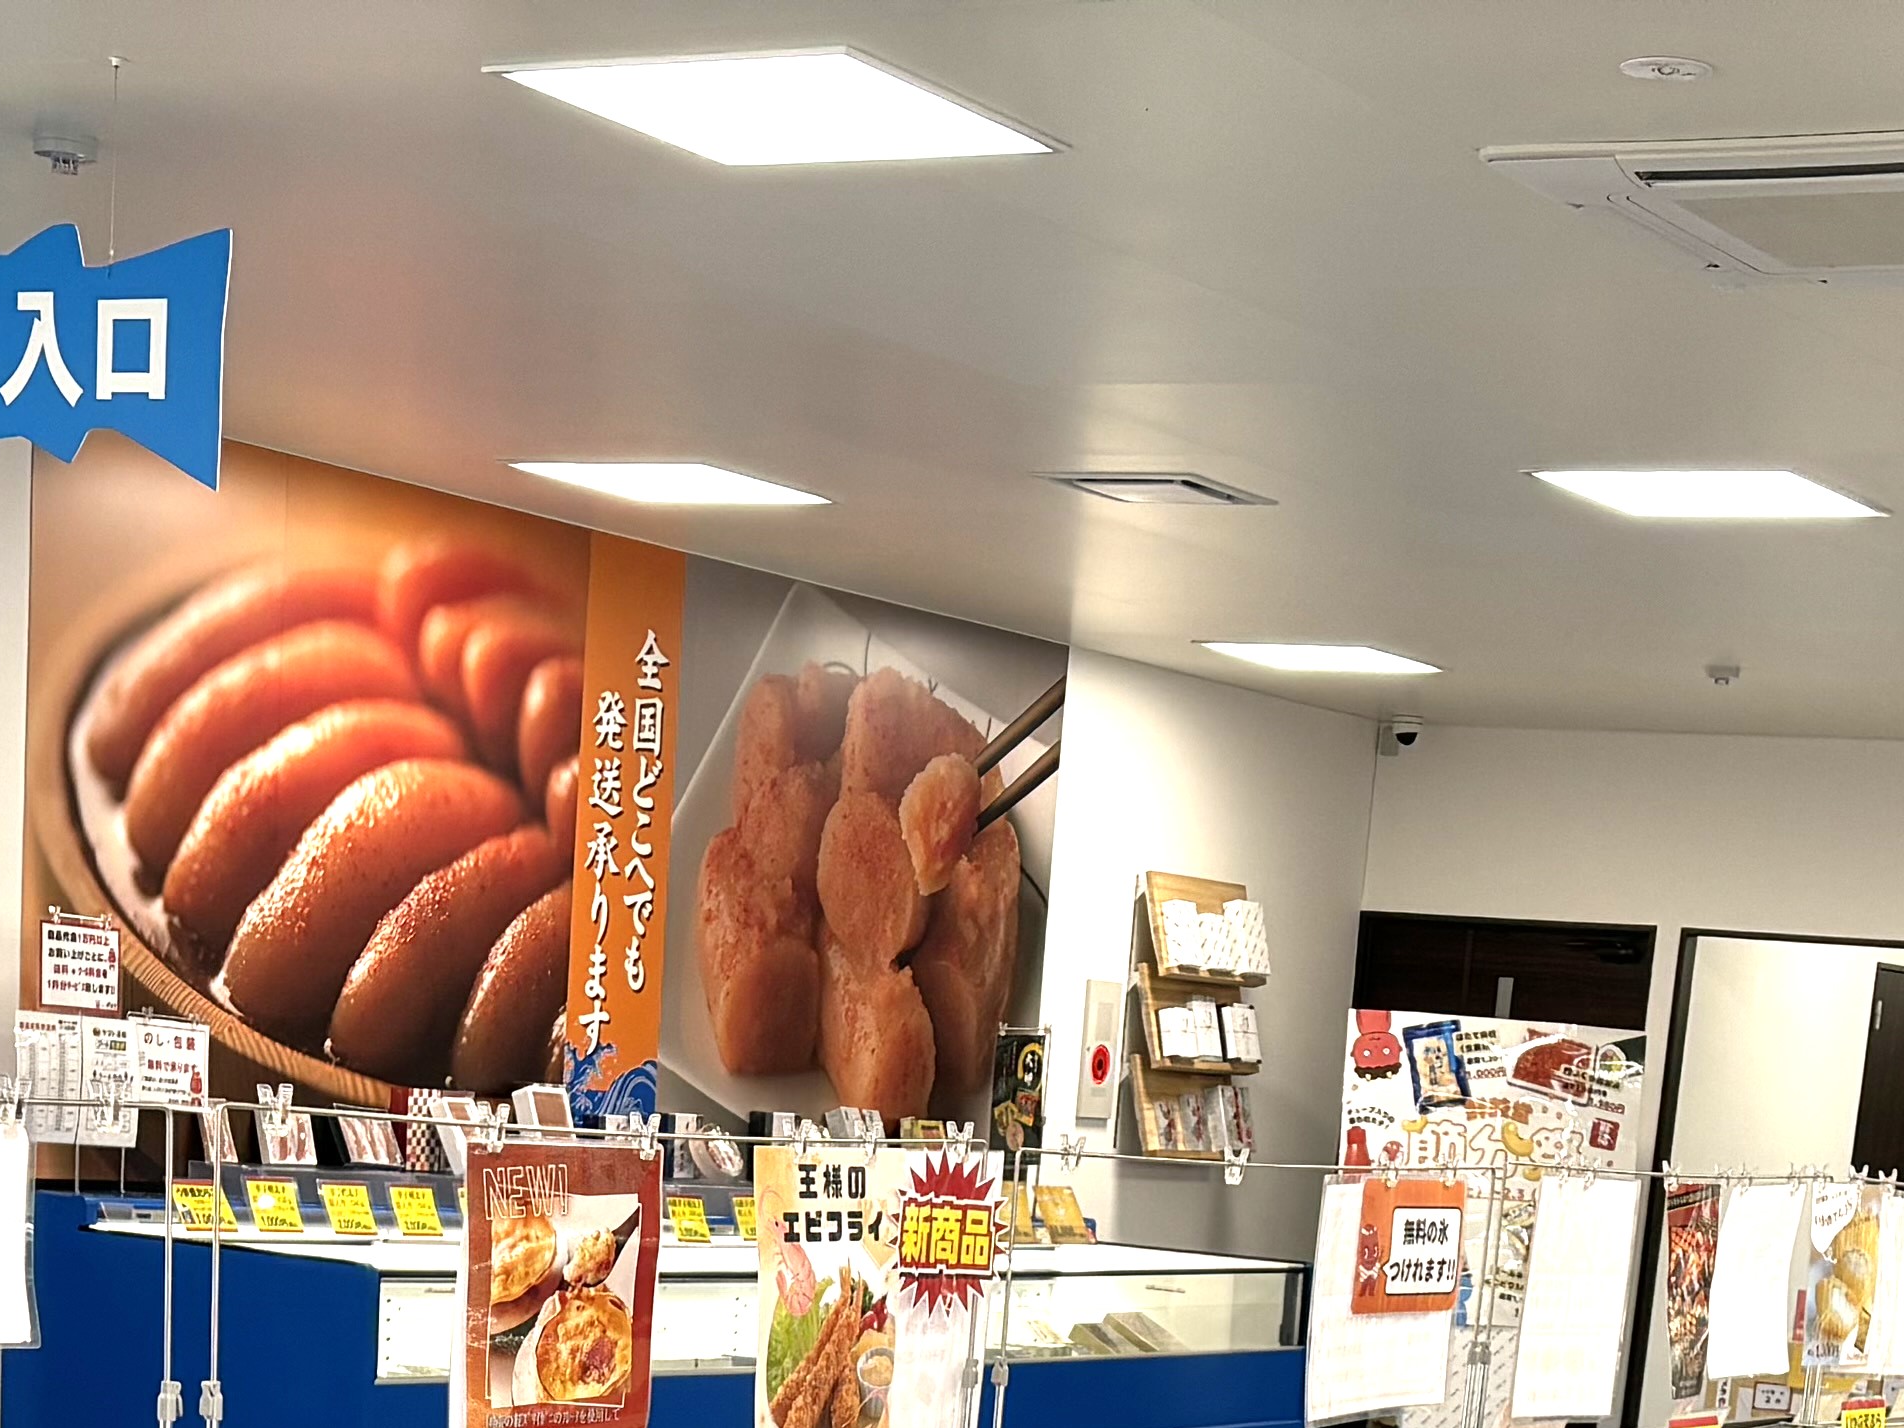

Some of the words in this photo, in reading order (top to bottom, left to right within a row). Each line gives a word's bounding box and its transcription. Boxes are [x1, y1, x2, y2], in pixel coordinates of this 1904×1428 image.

[623, 629, 671, 993] 全国どこへでも
[577, 689, 629, 1057] 発送承ります
[797, 1164, 866, 1199] 王様の
[782, 1210, 884, 1243] エビフライ
[901, 1199, 994, 1267] 新商品
[1402, 1218, 1449, 1246] 無料の氷
[1389, 1257, 1456, 1284] つけれます!!
